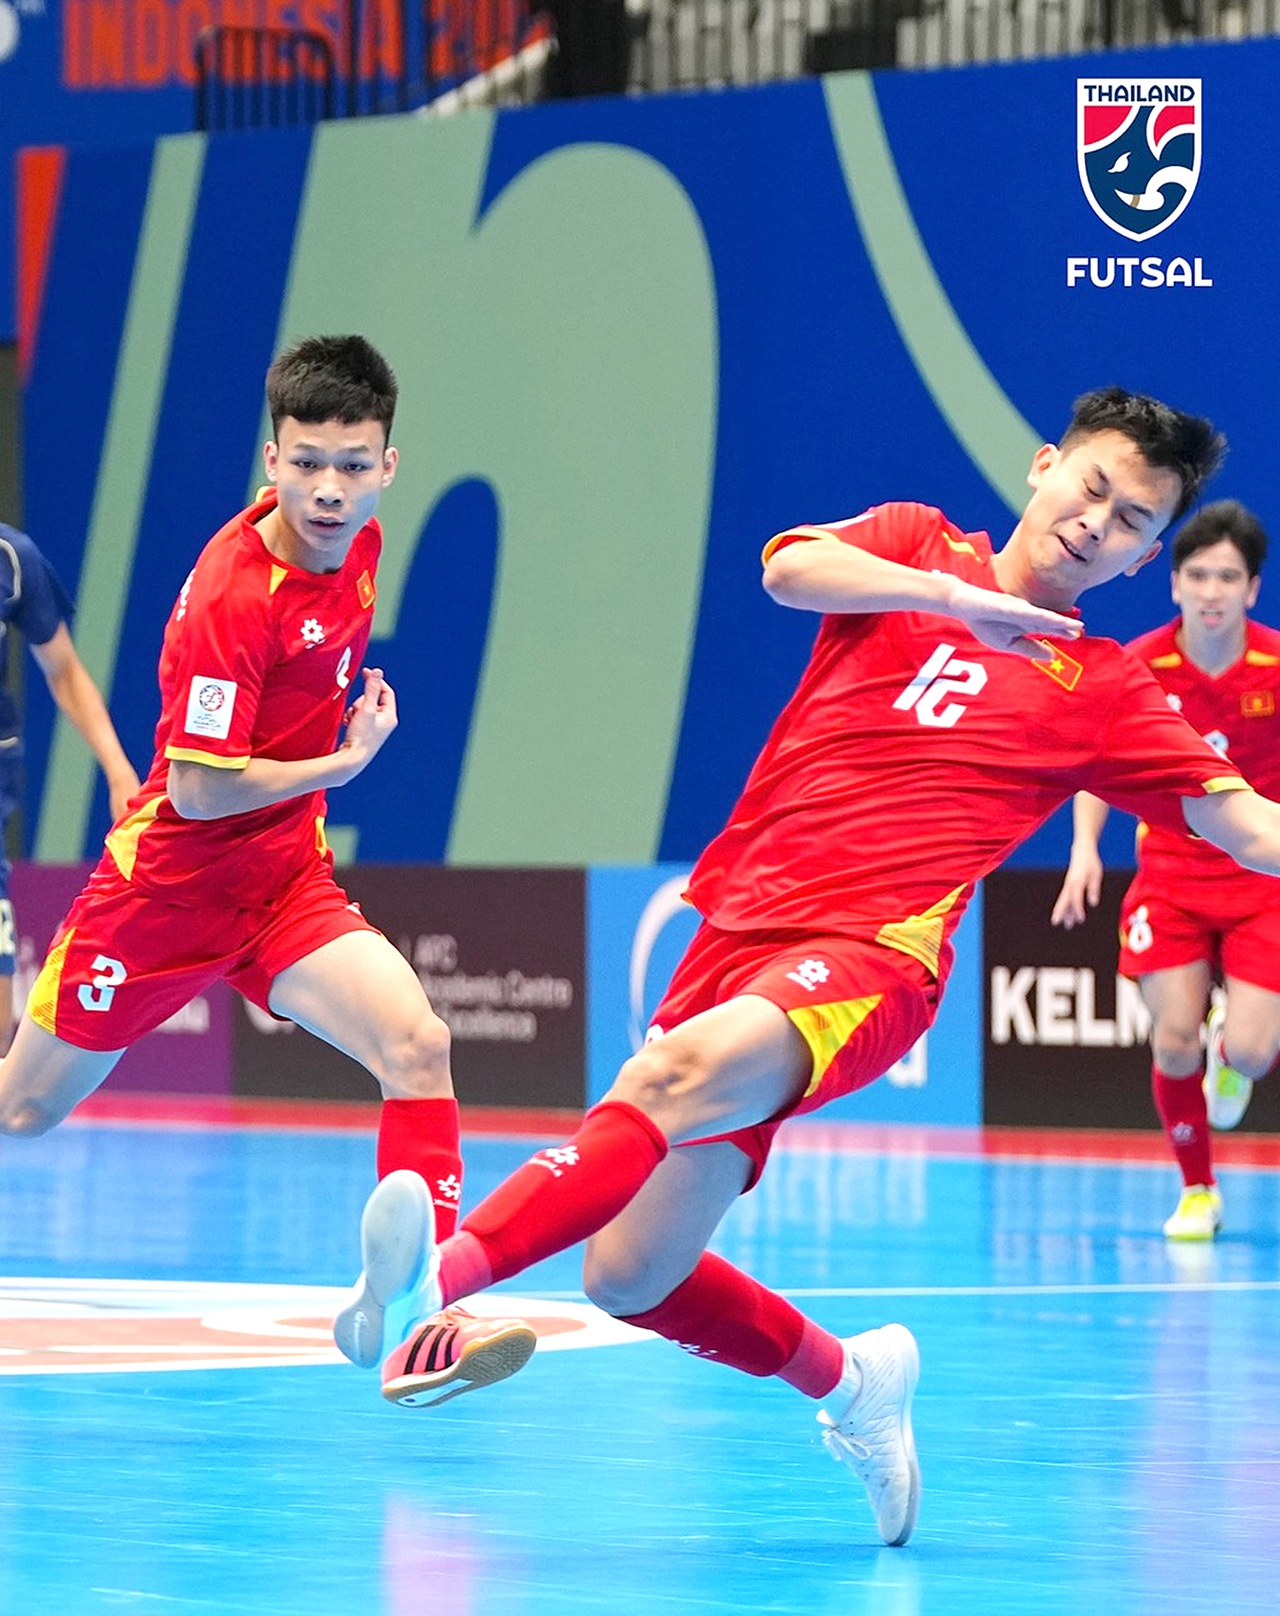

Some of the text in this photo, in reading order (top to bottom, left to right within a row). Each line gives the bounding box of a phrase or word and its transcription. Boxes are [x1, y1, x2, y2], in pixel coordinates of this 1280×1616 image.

[892, 643, 988, 728] 12
[77, 954, 127, 1012] 3
[990, 965, 1154, 1048] KELM
